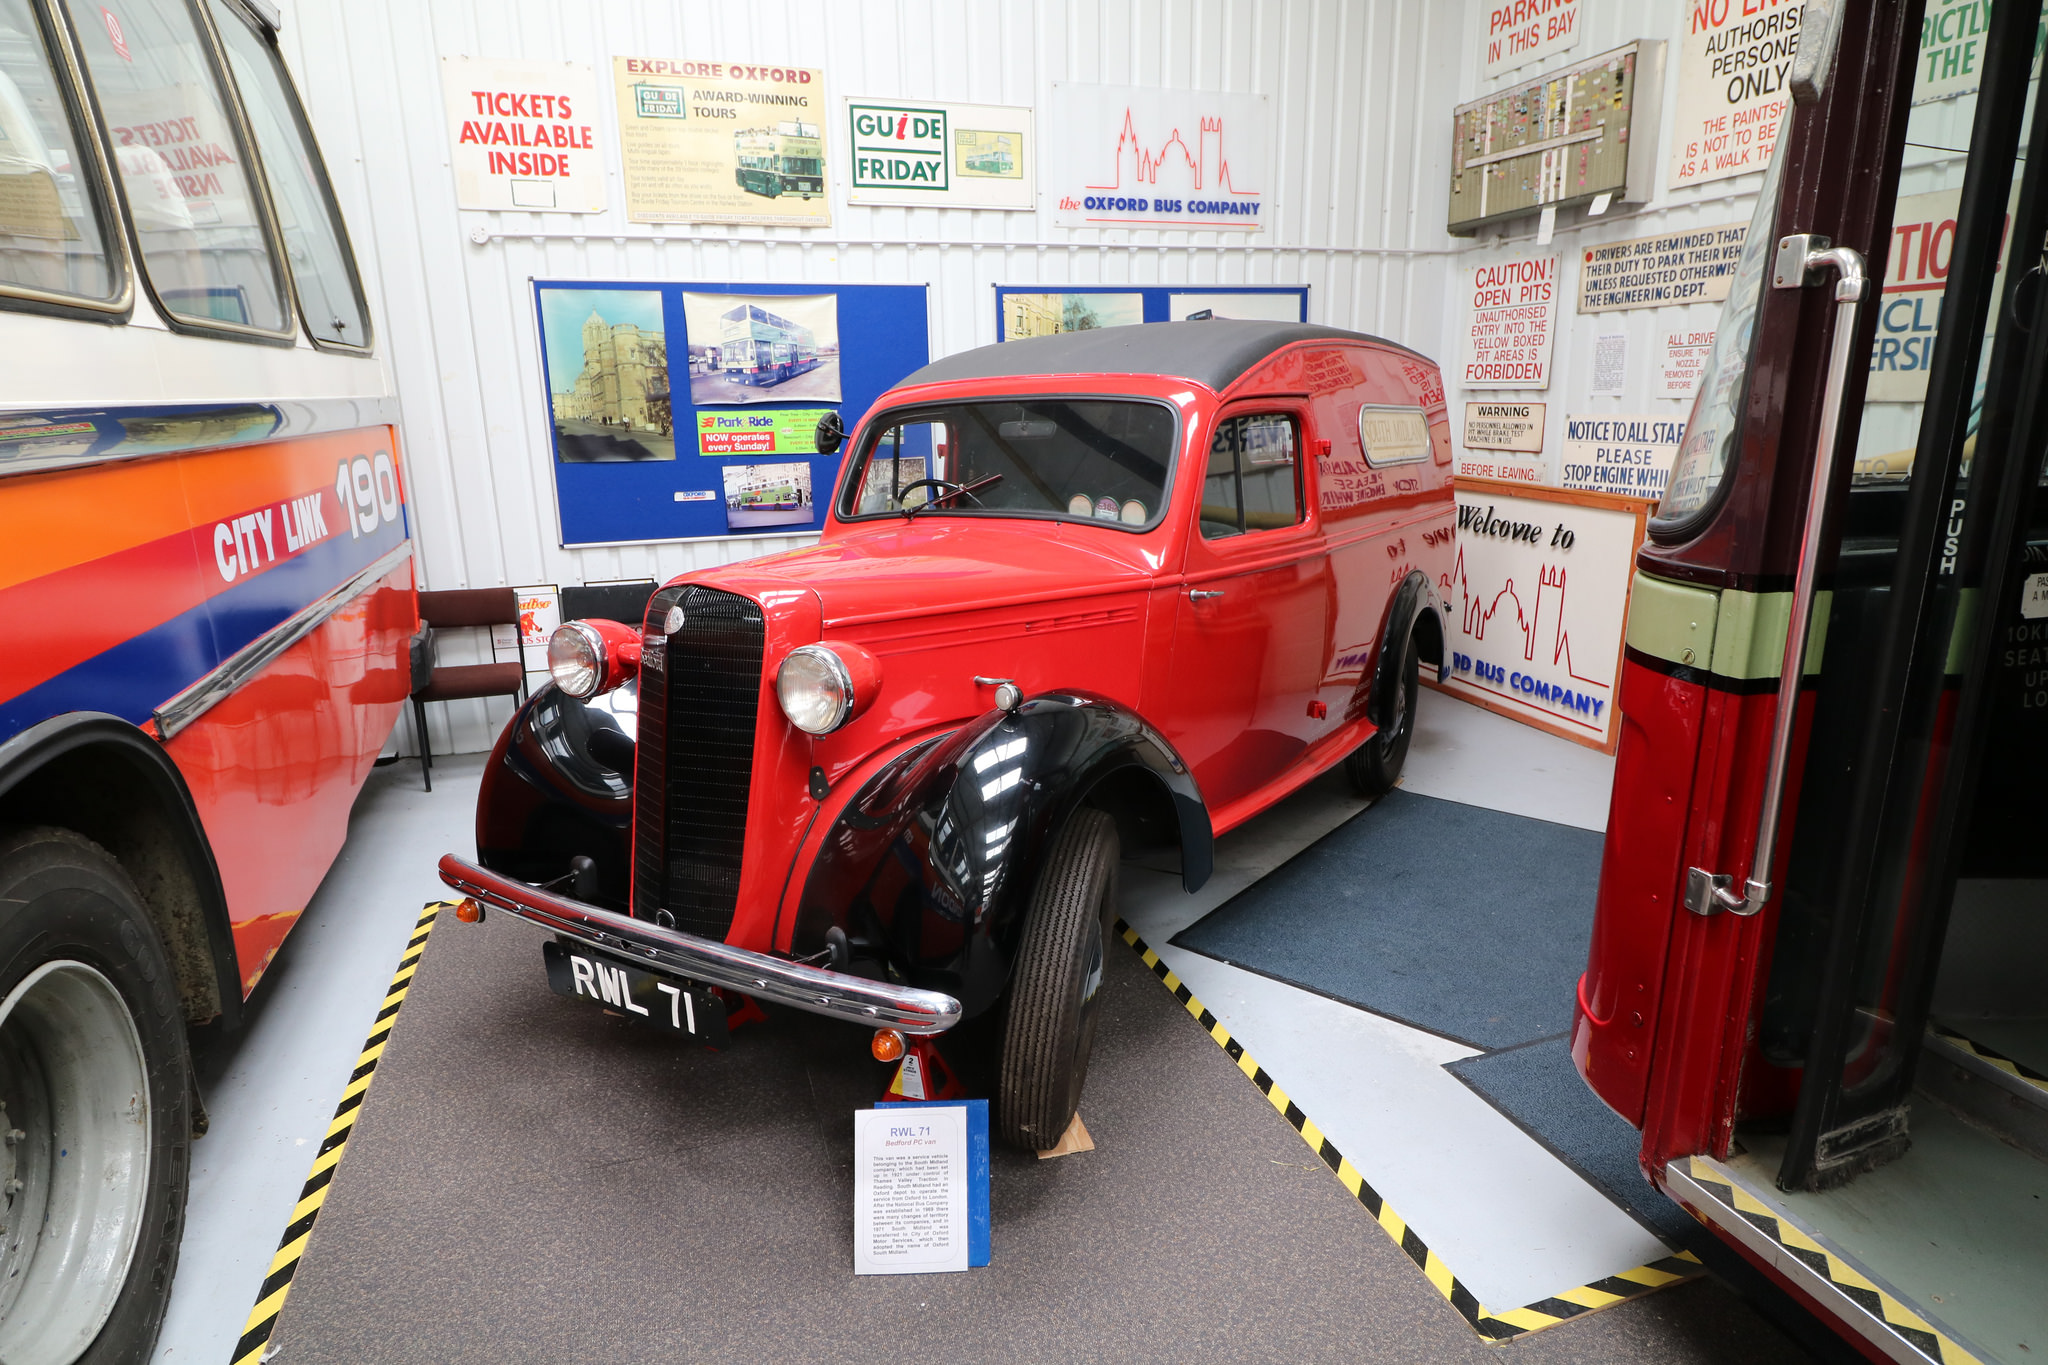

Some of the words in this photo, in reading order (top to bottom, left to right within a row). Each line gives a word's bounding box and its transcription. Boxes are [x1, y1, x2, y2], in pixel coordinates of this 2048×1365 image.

[1692, 0, 1729, 35] NO
[1488, 40, 1501, 65] IN
[1508, 23, 1540, 56] THIS
[1547, 8, 1576, 41] BAY
[1712, 31, 1799, 79] PERSONE
[1927, 40, 1977, 83] THE
[627, 59, 723, 76] EXPLORE
[729, 65, 811, 84] OXFORD
[1727, 61, 1790, 104] ONLY
[472, 91, 572, 119] TICKETS
[643, 104, 679, 115] FRIDAY
[693, 89, 808, 107] AWARD-WINNING
[693, 106, 737, 119] TOURS
[459, 121, 593, 149] AVAILABLE
[1704, 115, 1727, 136] THE
[1686, 142, 1698, 159] IS
[1703, 134, 1729, 154] NOT
[1736, 129, 1752, 146] TO
[1758, 122, 1777, 141] BE
[488, 151, 570, 177] INSIDE
[858, 158, 941, 181] FRIDAY
[1679, 161, 1695, 179] AS
[1700, 159, 1709, 174] A
[1716, 148, 1750, 170] WALK
[1757, 142, 1776, 160] TH
[1059, 196, 1081, 210] the
[1084, 197, 1149, 212] OXFORD
[1154, 199, 1183, 212] BUS
[1187, 201, 1261, 216] COMPANY
[1595, 245, 1632, 262] DRIVERS
[1634, 241, 1653, 255] ARE
[1656, 232, 1714, 254] REMINDED
[1717, 227, 1747, 243] THAT
[1586, 263, 1612, 278] THEIR
[1614, 259, 1640, 274] DUTY
[1642, 256, 1656, 271] TO
[1658, 253, 1685, 268] PARK
[1688, 248, 1719, 264] THEIR
[1722, 245, 1742, 258] VEH
[1585, 277, 1617, 292] UNLESS
[1619, 269, 1676, 288] REQUESTED
[1679, 262, 1737, 281] OTHERWIS
[1474, 287, 1511, 308] OPEN
[1520, 282, 1551, 303] PITS
[1584, 294, 1601, 307] THE
[1603, 286, 1671, 306] ENGINEERING
[1673, 282, 1707, 298] DEPT.
[1476, 306, 1547, 324] UNAUTHORISED
[1472, 324, 1500, 337] ENTRY
[1504, 322, 1525, 335] INTO
[1529, 320, 1547, 333] THE
[1668, 334, 1684, 346] ALL
[1688, 331, 1716, 344] DRIVE
[1473, 337, 1509, 350] YELLOW
[1513, 334, 1545, 347] BOXED
[1669, 349, 1694, 358] ENSURE
[1476, 351, 1490, 362] PIT
[1494, 350, 1524, 361] AREAS
[1528, 348, 1537, 360] IS
[1676, 359, 1700, 368] NOZZLE
[1466, 363, 1543, 380] FORBIDDEN
[1664, 370, 1694, 378] REMOVED
[1667, 381, 1691, 390] BEFORE
[717, 417, 742, 427] Park
[749, 416, 773, 427] Ride
[1478, 406, 1530, 417] WARNING
[706, 434, 728, 442] NOW
[731, 433, 770, 442] operates
[1568, 421, 1610, 441] NOTICE
[1612, 422, 1627, 442] TO
[1627, 422, 1649, 442] ALL
[1651, 423, 1685, 444] STAF
[708, 443, 732, 452] every
[734, 442, 769, 452] Sunday!
[1597, 448, 1652, 465] PLEASE
[1461, 463, 1494, 477] BEFORE
[1564, 464, 1592, 482] STOP
[1594, 465, 1634, 485] ENGINE
[1637, 468, 1669, 488] WHI
[335, 450, 399, 540] 190
[213, 508, 275, 583] CITY
[280, 492, 328, 553] LINK
[1457, 504, 1543, 545] Welcome
[1550, 523, 1575, 549] to
[1939, 499, 1965, 575] PUSH
[1475, 660, 1506, 683] BUS
[1510, 671, 1604, 717] COMPANY
[570, 955, 649, 1017] RWL
[657, 982, 695, 1035] 71
[891, 1128, 915, 1137] RWL
[919, 1127, 930, 1136] 71
